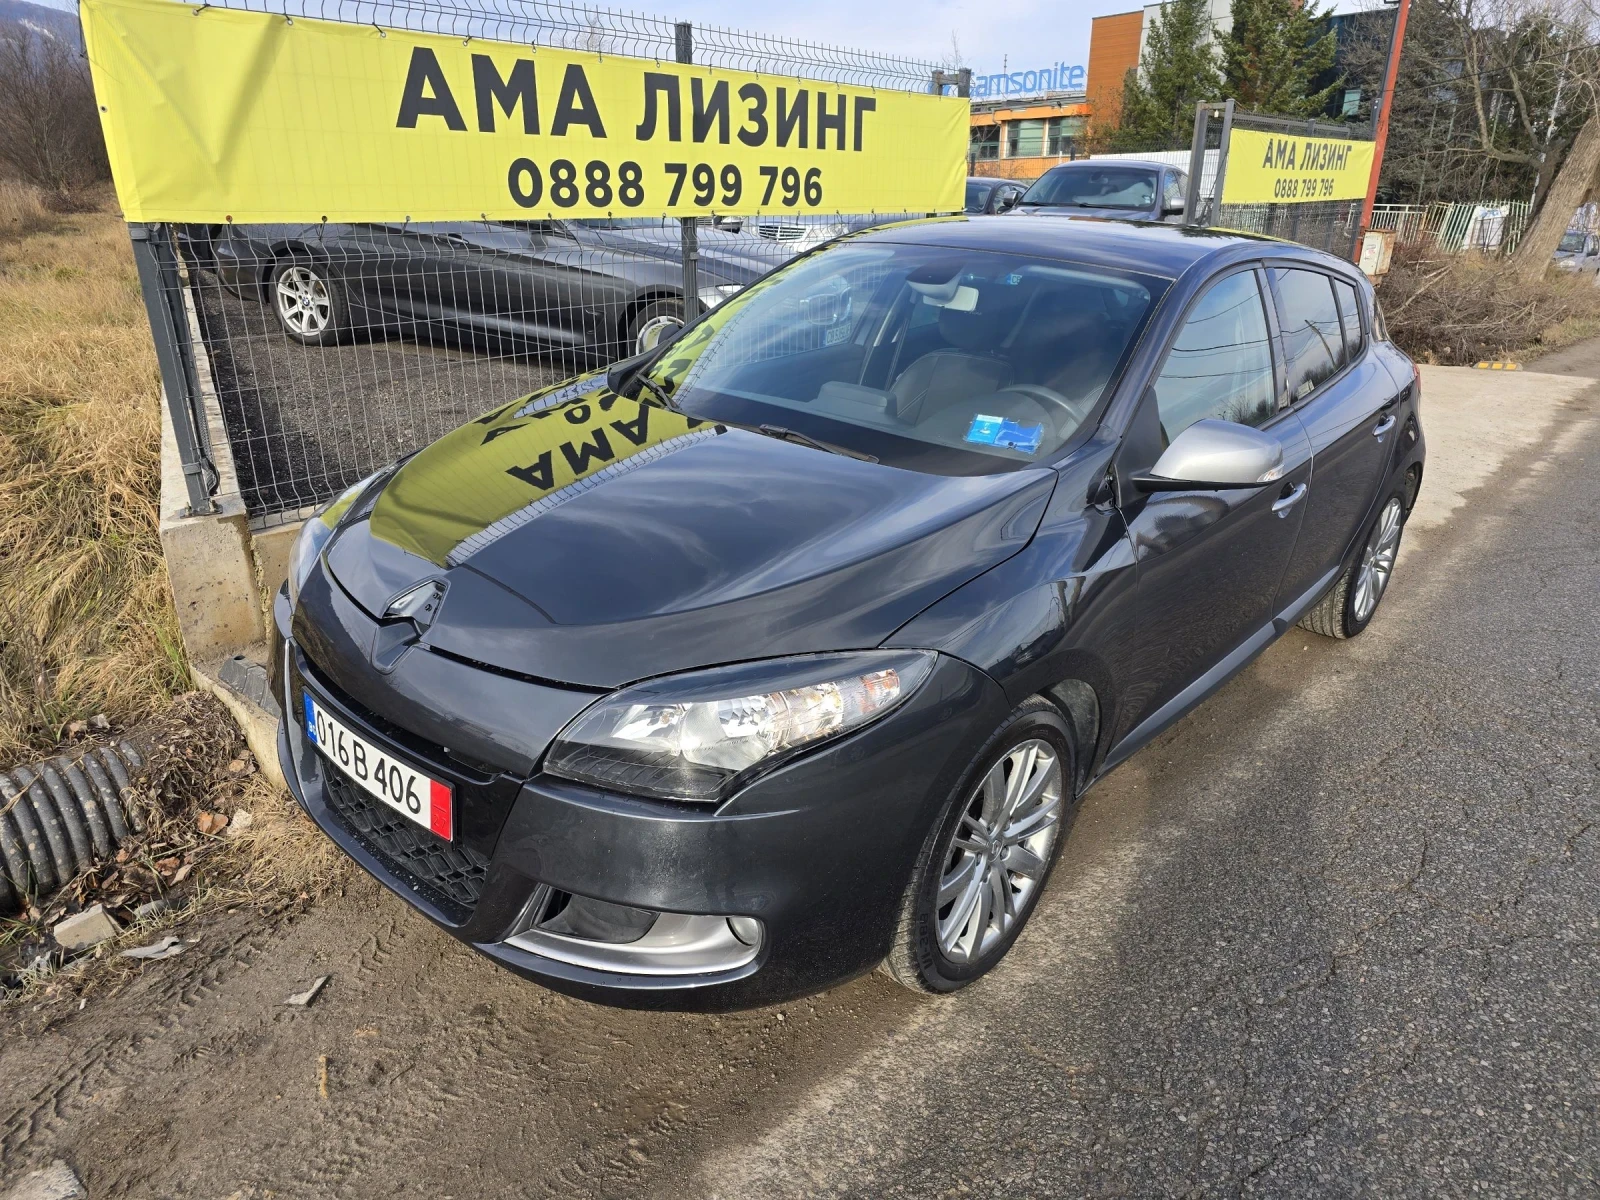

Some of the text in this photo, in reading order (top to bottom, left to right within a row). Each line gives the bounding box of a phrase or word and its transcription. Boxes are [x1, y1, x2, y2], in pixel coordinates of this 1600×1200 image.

[970, 61, 1084, 97] amsonite
[396, 46, 877, 152] АМА ЛИЗИНГ
[1262, 138, 1352, 170] АМА ЛИЗИНГ
[508, 158, 823, 208] 0888 799 796
[1274, 178, 1334, 198] 0888 799 796
